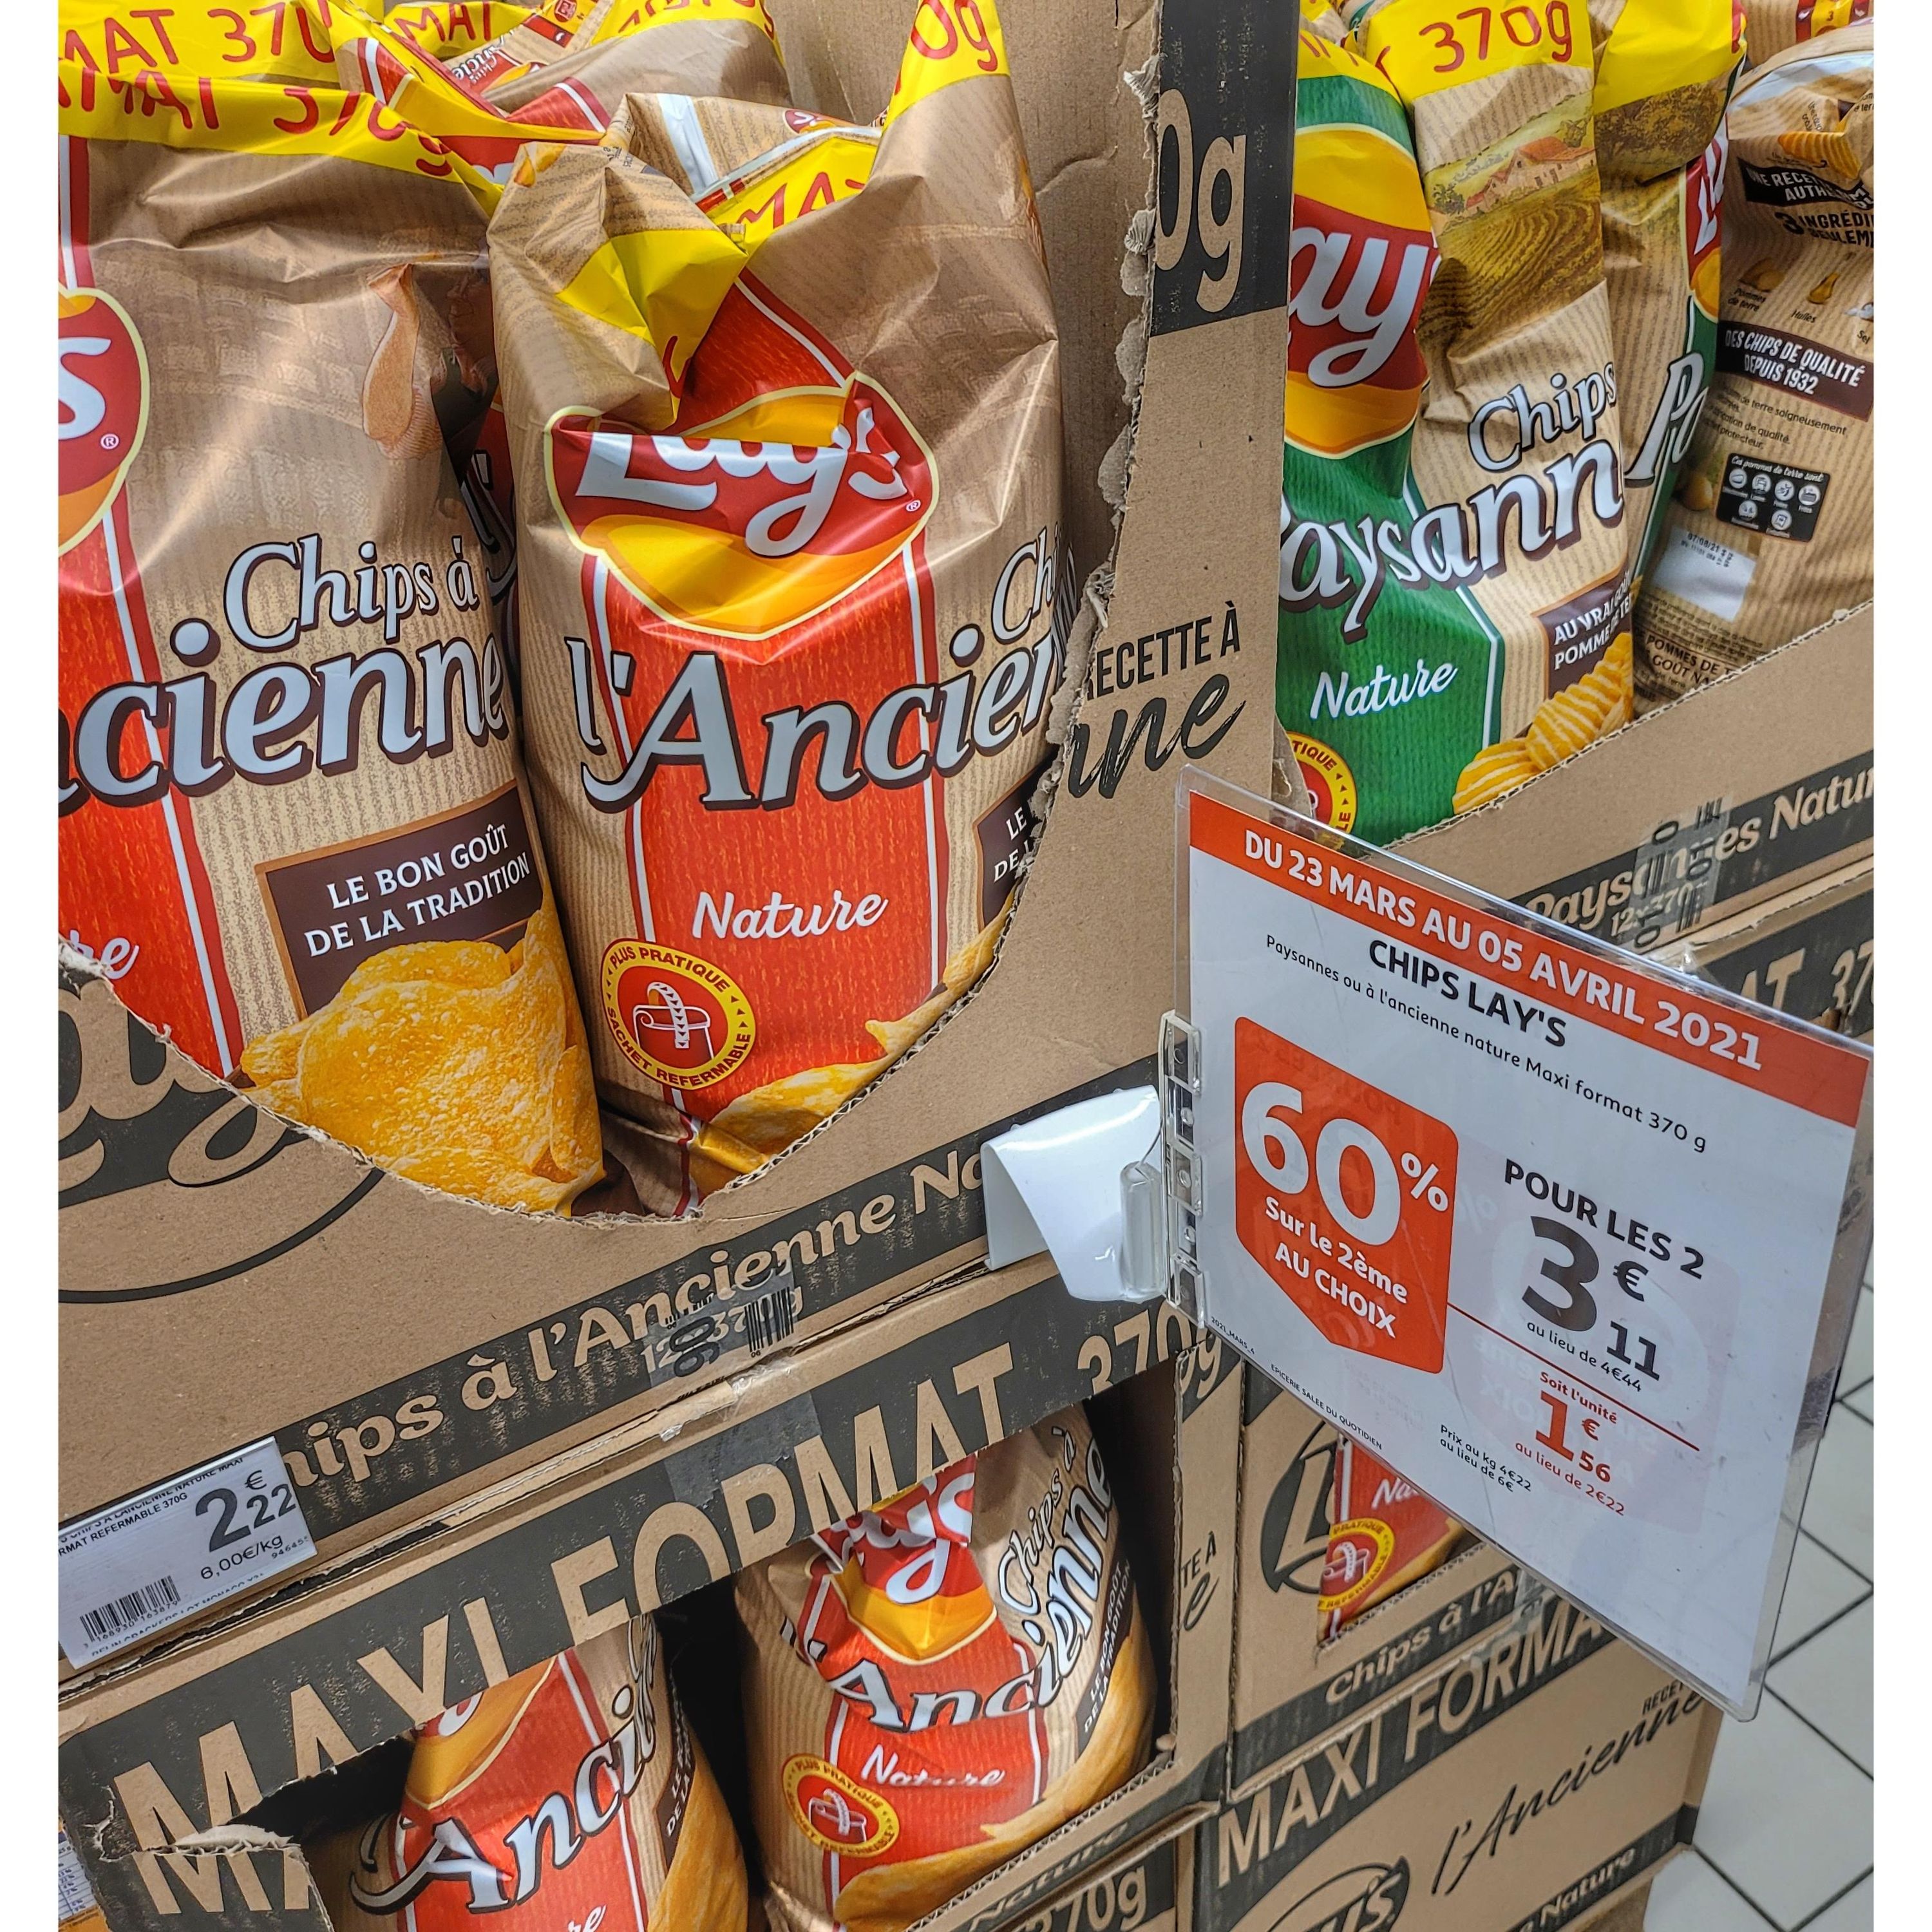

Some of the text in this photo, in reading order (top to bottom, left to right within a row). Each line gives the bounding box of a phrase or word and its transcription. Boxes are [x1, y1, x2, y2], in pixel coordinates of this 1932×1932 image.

[1419, 1, 1572, 72] 370g
[1744, 331, 1783, 357] CHIPS
[1779, 341, 1803, 363] DE
[1799, 348, 1866, 388] QUALITÉ
[1744, 354, 1819, 395] DEPUIS 1932
[1468, 362, 1617, 471] Chips
[1774, 408, 1848, 436] soigneusement
[1280, 439, 1624, 645] aysann
[223, 533, 480, 651] Chips à
[1220, 601, 1242, 656] À
[1554, 619, 1577, 646] AU
[1577, 596, 1615, 631] VRAI
[1309, 658, 1457, 721] Nature
[1652, 654, 1690, 677] GOÛT
[1700, 659, 1721, 675] DE
[1005, 805, 1027, 840] LE
[304, 851, 531, 958] DE LA TRADITION
[327, 822, 509, 910] LE BON GOÛT
[994, 852, 1019, 883] DE
[692, 890, 889, 939] Nature
[1245, 829, 1763, 1072] DU 23 MARS AU 05 AVRIL 2021
[609, 946, 731, 993] PLUS PRATIQUE
[1368, 939, 1567, 1048] CHIPS LAY'S
[607, 1007, 751, 1087] SACHET REFERMABLE
[1266, 934, 1707, 1154] Paysannes ou à l'ancienne nature Maxi format 370 g
[1265, 1196, 1408, 1305] Sur le 2ème
[1504, 1157, 1705, 1280] POUR LES 2
[461, 1353, 517, 1411] à
[527, 1193, 898, 1384] l'Ancienne
[1274, 1242, 1396, 1340] AU CHOIX
[1527, 1320, 1642, 1393] au lieu de 4€44
[1270, 1363, 1383, 1451] EPICERIE SALEE DU QUOTIDIEN
[1540, 1370, 1618, 1425] Soit l'unité
[1439, 1439, 1515, 1493] au lieu de 6€
[1440, 1423, 1532, 1493] Prix au kg 4€22
[1515, 1441, 1625, 1517] au lieu de 2€22
[58, 1492, 188, 1557] RMAT REFERMABLE 370G
[998, 1468, 1063, 1613] Chips
[1325, 1596, 1463, 1705] Chips à
[1217, 1597, 1610, 1888] MAXI FORMA
[1430, 1690, 1705, 1897] l'Ancienne
[1539, 1846, 1637, 1926] Nature
